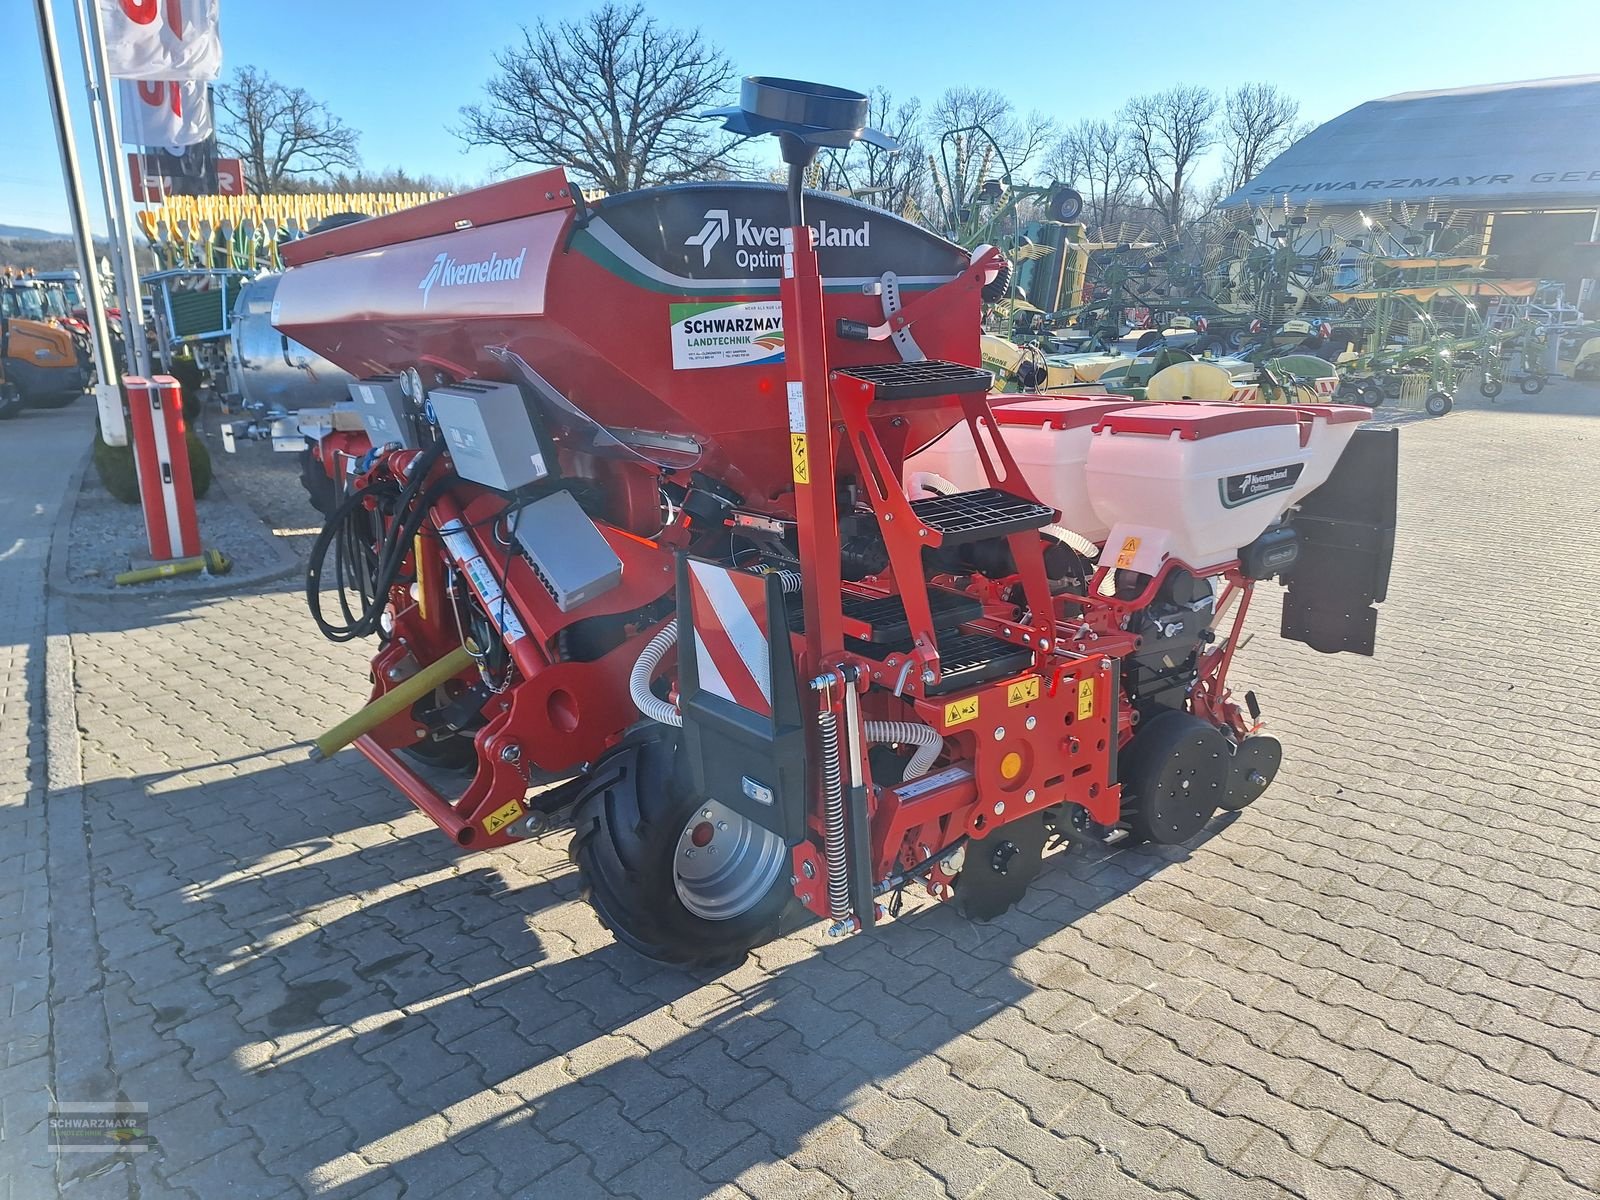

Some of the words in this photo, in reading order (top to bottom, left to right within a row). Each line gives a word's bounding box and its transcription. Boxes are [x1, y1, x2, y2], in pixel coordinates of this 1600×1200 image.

[1250, 173, 1514, 196] SCHWARZMAYR
[440, 247, 527, 287] Kverneland
[735, 249, 784, 272] Optim
[683, 317, 781, 334] SCHWARZMAY
[687, 336, 751, 347] LANDTECHNIK
[988, 355, 1008, 366] KRONE
[1250, 468, 1288, 485] Kverneland
